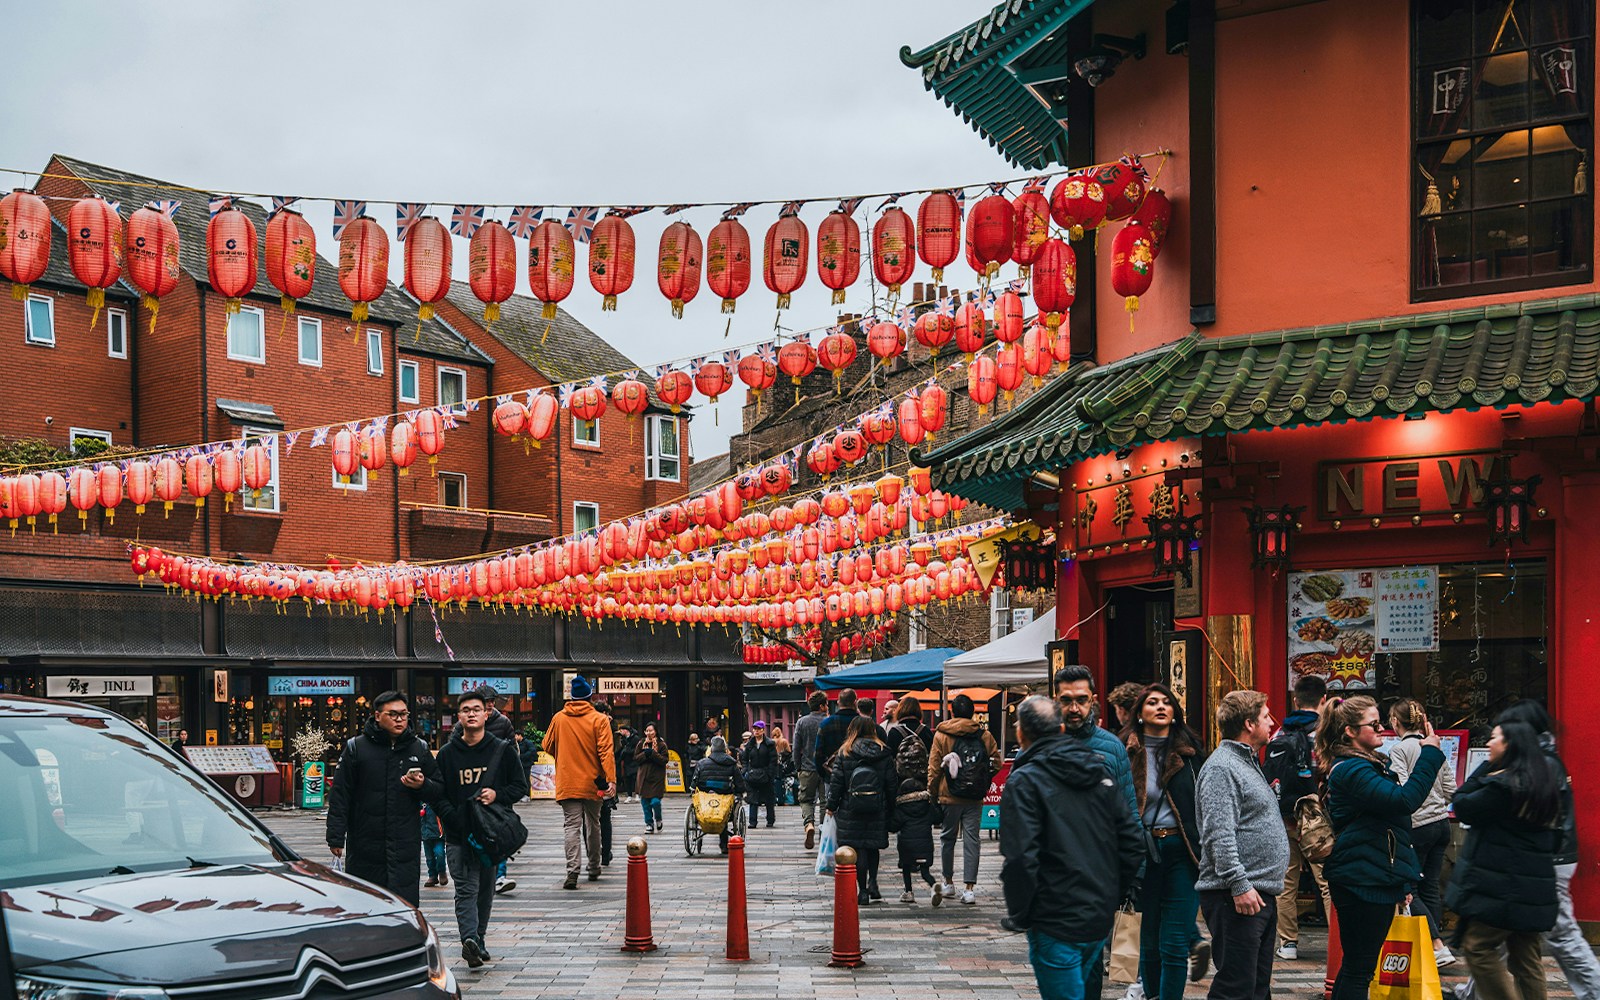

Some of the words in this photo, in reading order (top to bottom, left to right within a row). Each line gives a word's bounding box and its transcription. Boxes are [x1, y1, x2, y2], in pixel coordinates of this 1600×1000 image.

[1326, 457, 1497, 513] NEW
[102, 680, 136, 695] JINLI
[296, 679, 318, 688] CHINA
[320, 679, 351, 688] MODERN
[604, 681, 626, 690] HIGH
[635, 680, 655, 690] YAKI
[1383, 955, 1409, 972] LEGO
